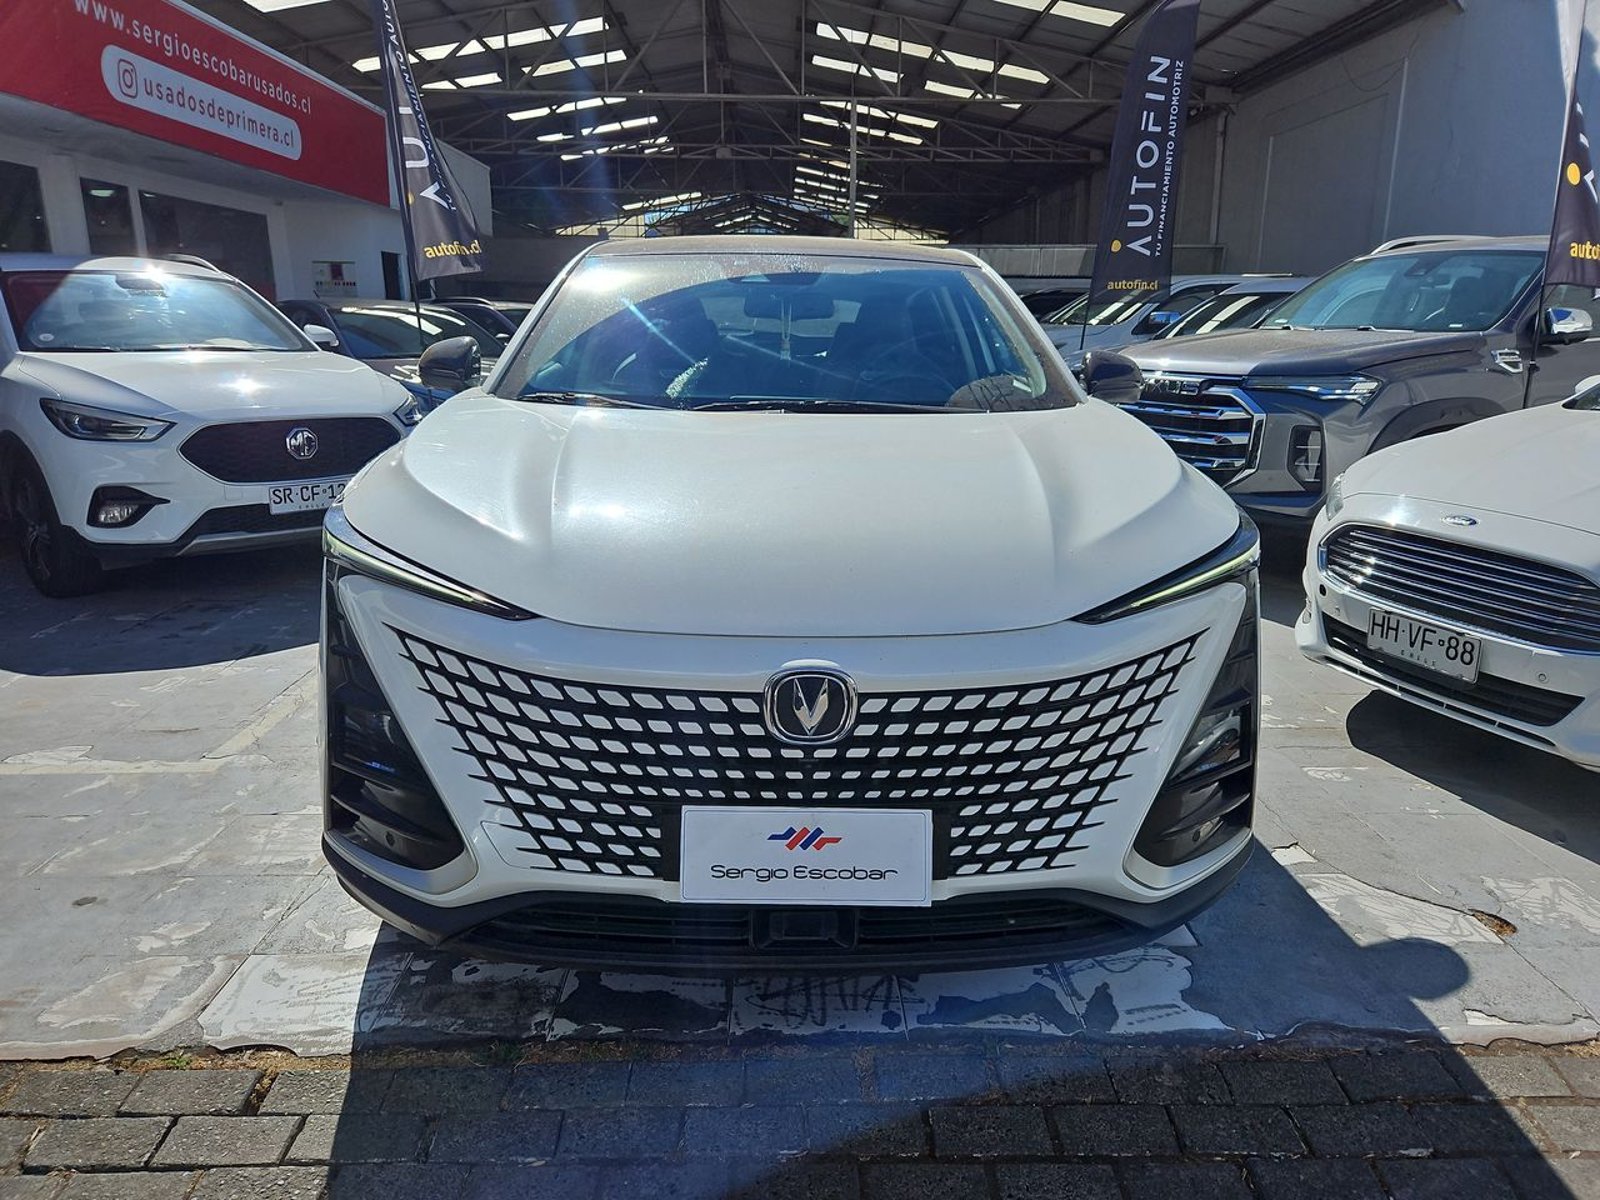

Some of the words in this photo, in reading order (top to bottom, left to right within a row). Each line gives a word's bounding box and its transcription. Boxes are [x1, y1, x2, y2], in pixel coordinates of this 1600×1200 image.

[75, 0, 312, 115] www.sergioescobarusados.cl
[143, 75, 295, 148] usadosdeprimera.cl
[1168, 59, 1184, 138] AUTOMOTRIZ
[1126, 55, 1171, 257] AUTOFIN
[1157, 140, 1176, 241] FINANCIAMIENTO
[1107, 279, 1159, 291] autofin.cl
[1154, 243, 1163, 257] TU
[1569, 241, 1600, 261] auto
[710, 864, 789, 882] Sergio
[793, 865, 899, 881] Escobar
